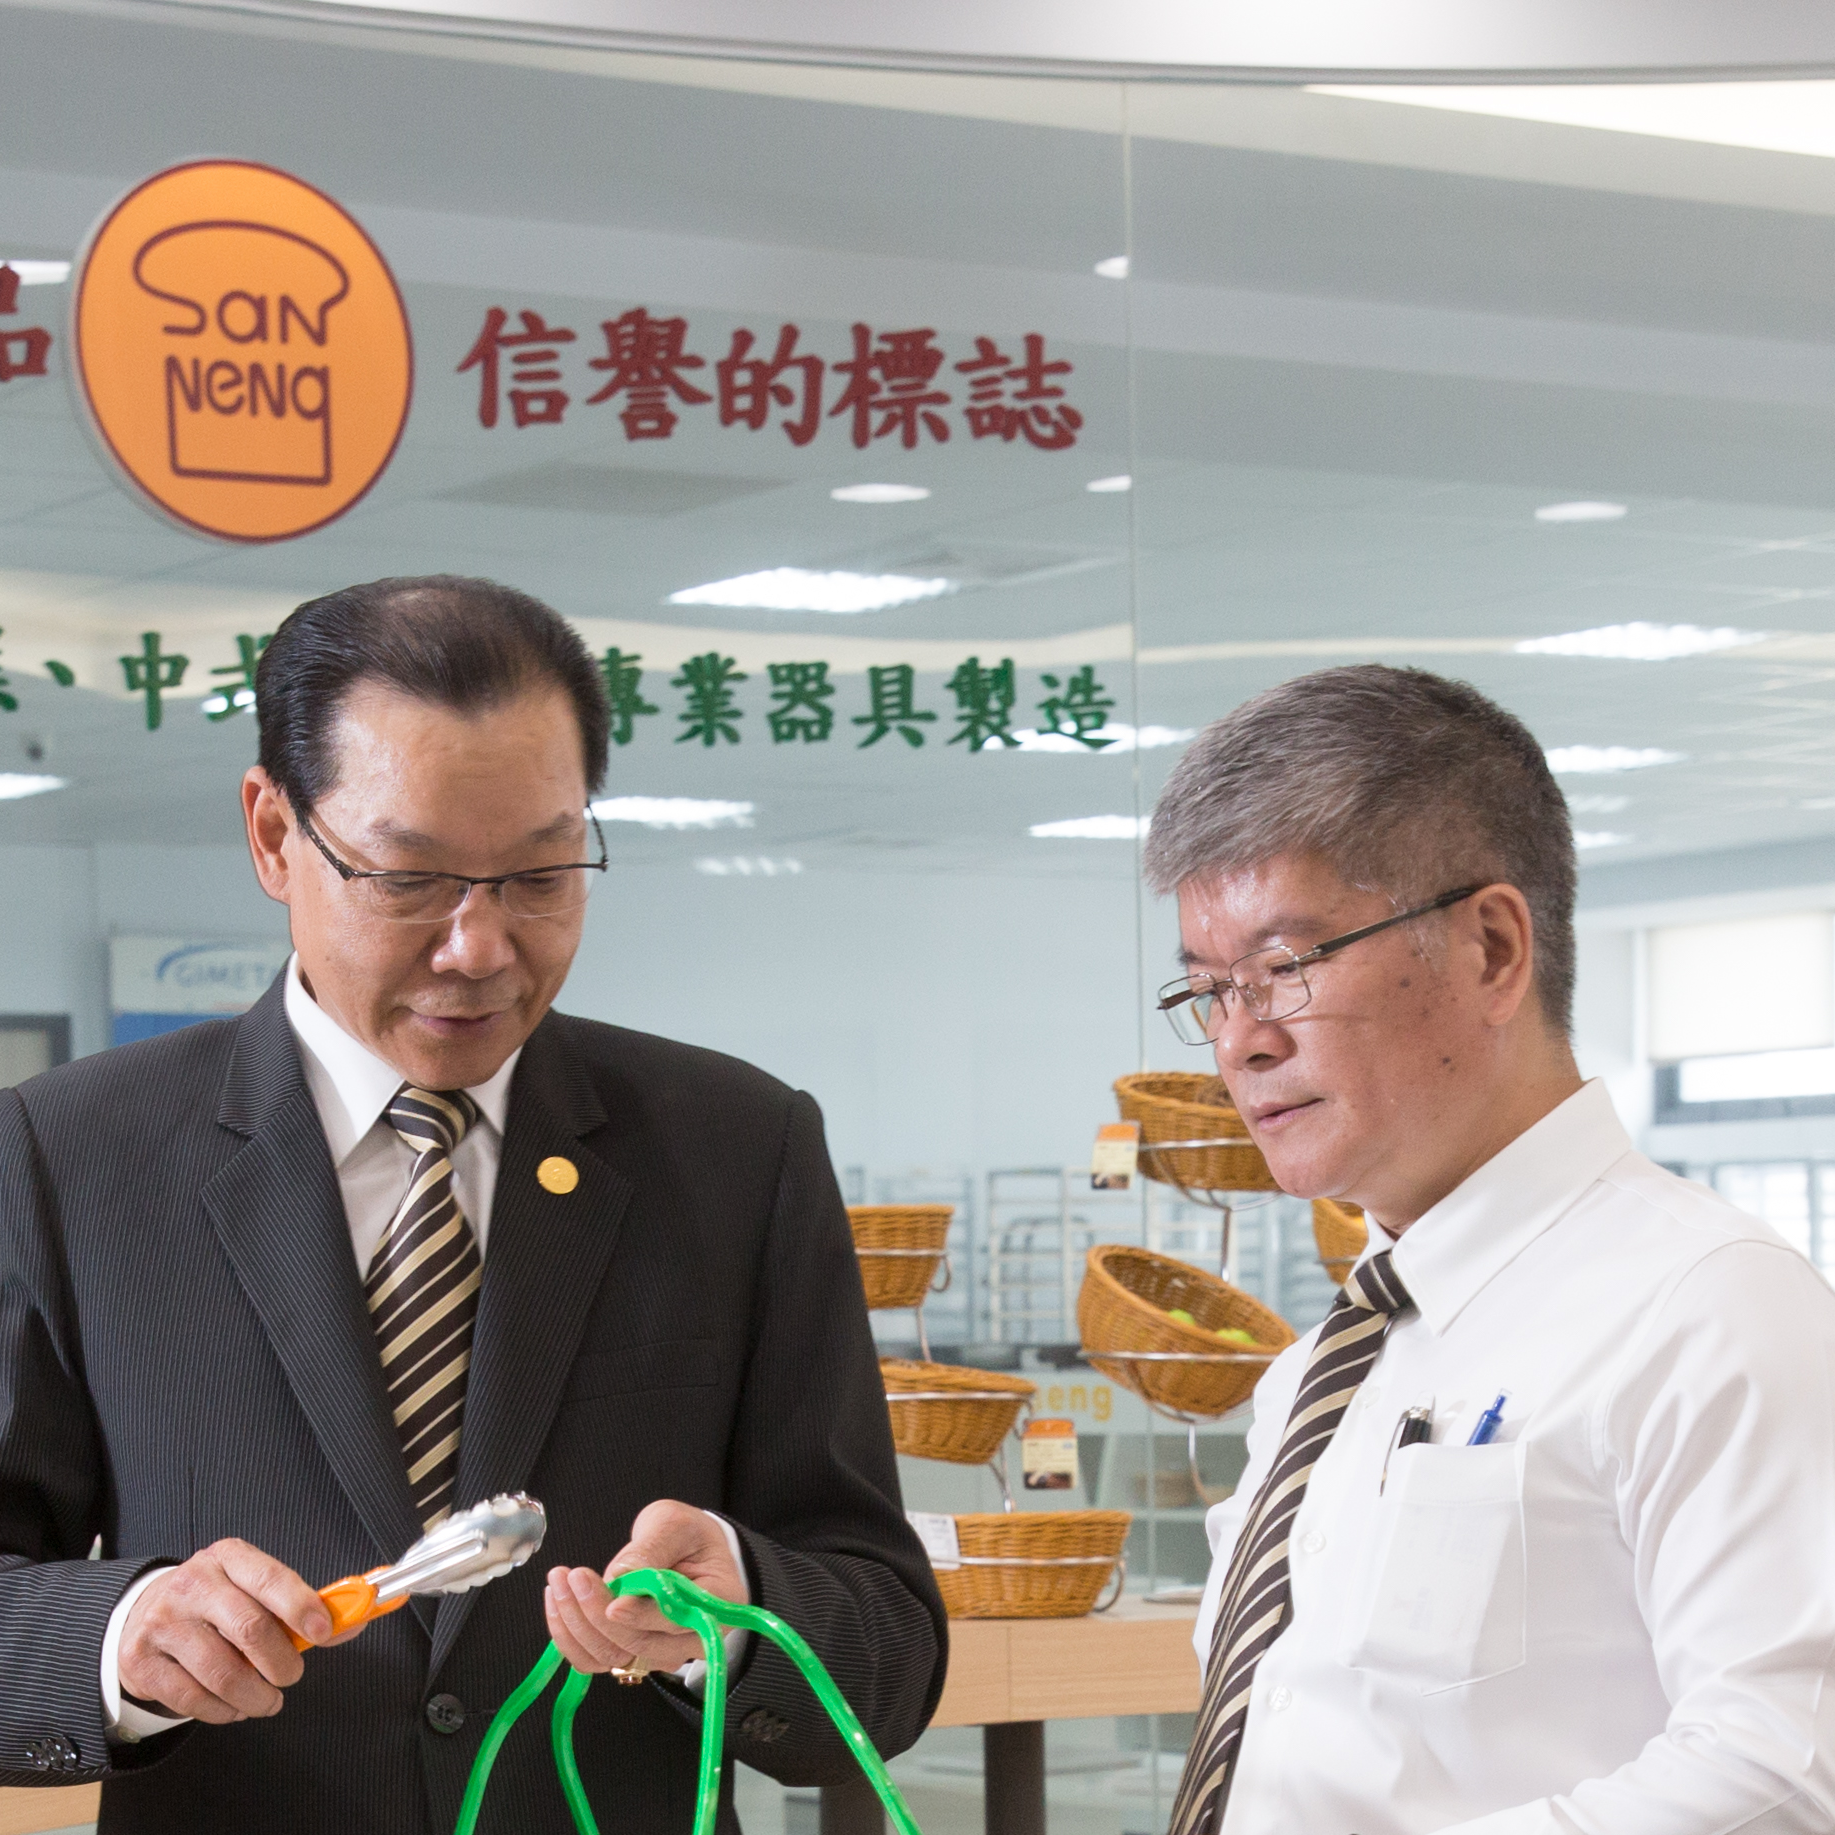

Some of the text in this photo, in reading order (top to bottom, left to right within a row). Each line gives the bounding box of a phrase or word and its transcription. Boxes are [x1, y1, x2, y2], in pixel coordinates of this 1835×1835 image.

[456, 306, 1084, 451] 信譽的標誌
